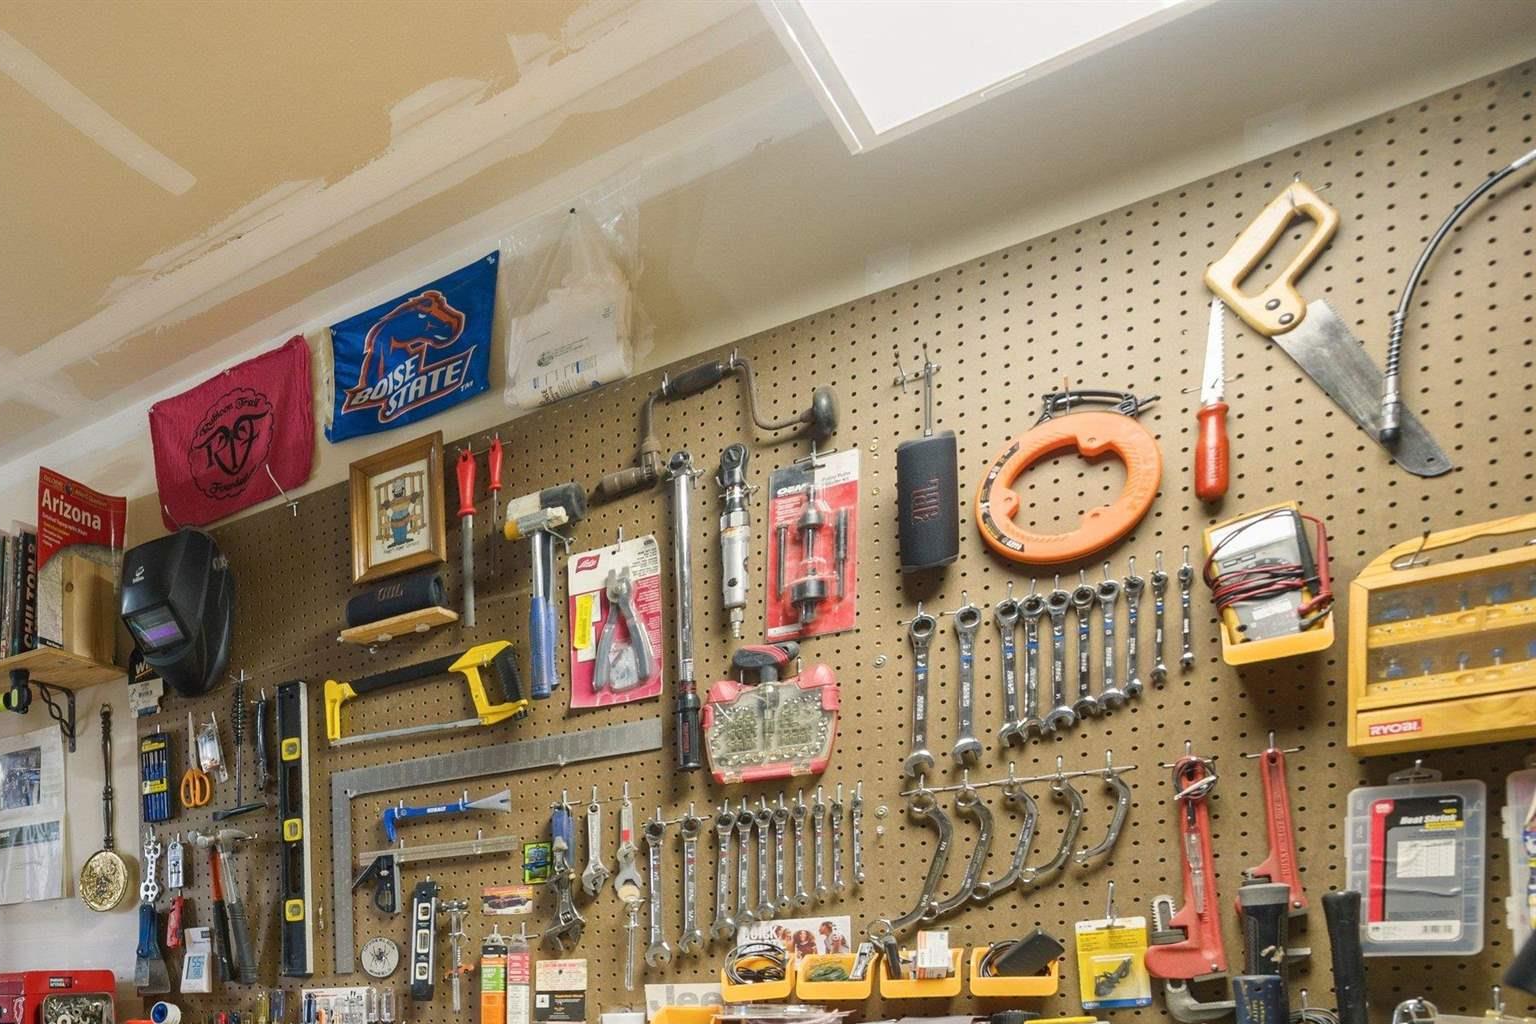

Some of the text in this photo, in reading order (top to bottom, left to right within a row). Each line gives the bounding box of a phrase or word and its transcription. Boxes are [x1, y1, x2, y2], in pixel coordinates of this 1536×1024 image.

[351, 354, 419, 405] BOISE
[386, 360, 462, 416] STATE
[42, 488, 101, 530] Arizona
[1370, 721, 1421, 736] RYOBI
[1400, 814, 1457, 824] Heat Shrink
